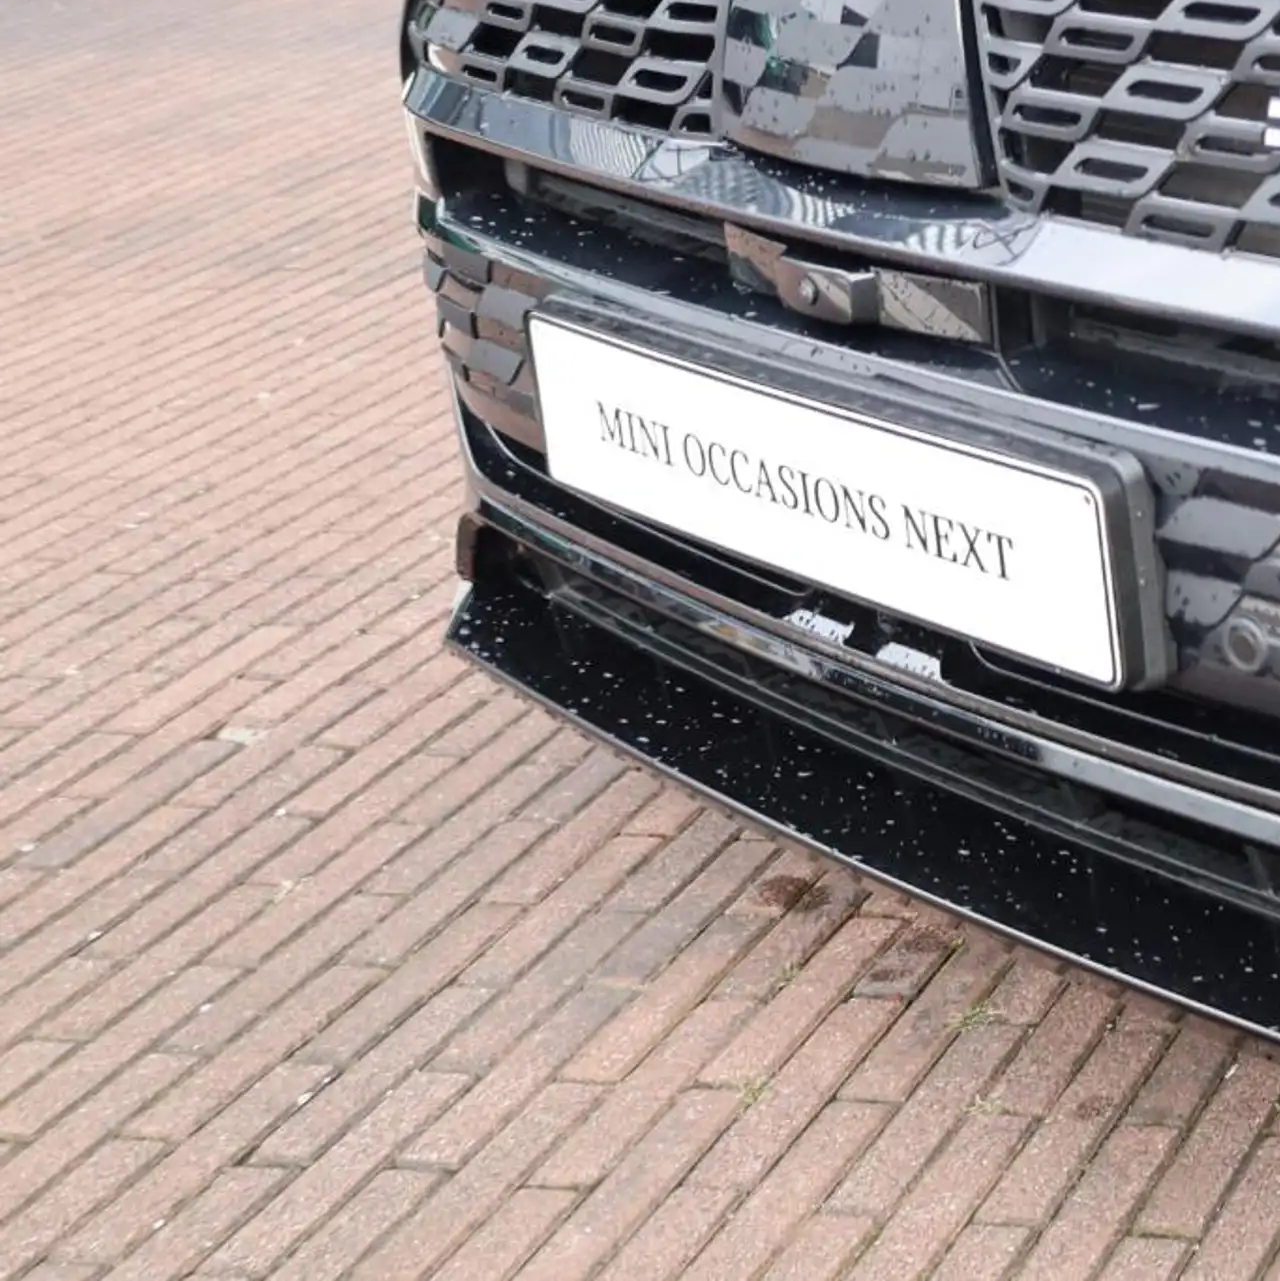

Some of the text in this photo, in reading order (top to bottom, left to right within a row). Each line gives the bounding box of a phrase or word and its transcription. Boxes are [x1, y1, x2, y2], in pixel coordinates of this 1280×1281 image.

[597, 398, 1014, 581] MINI OCCASIONS NEXT
